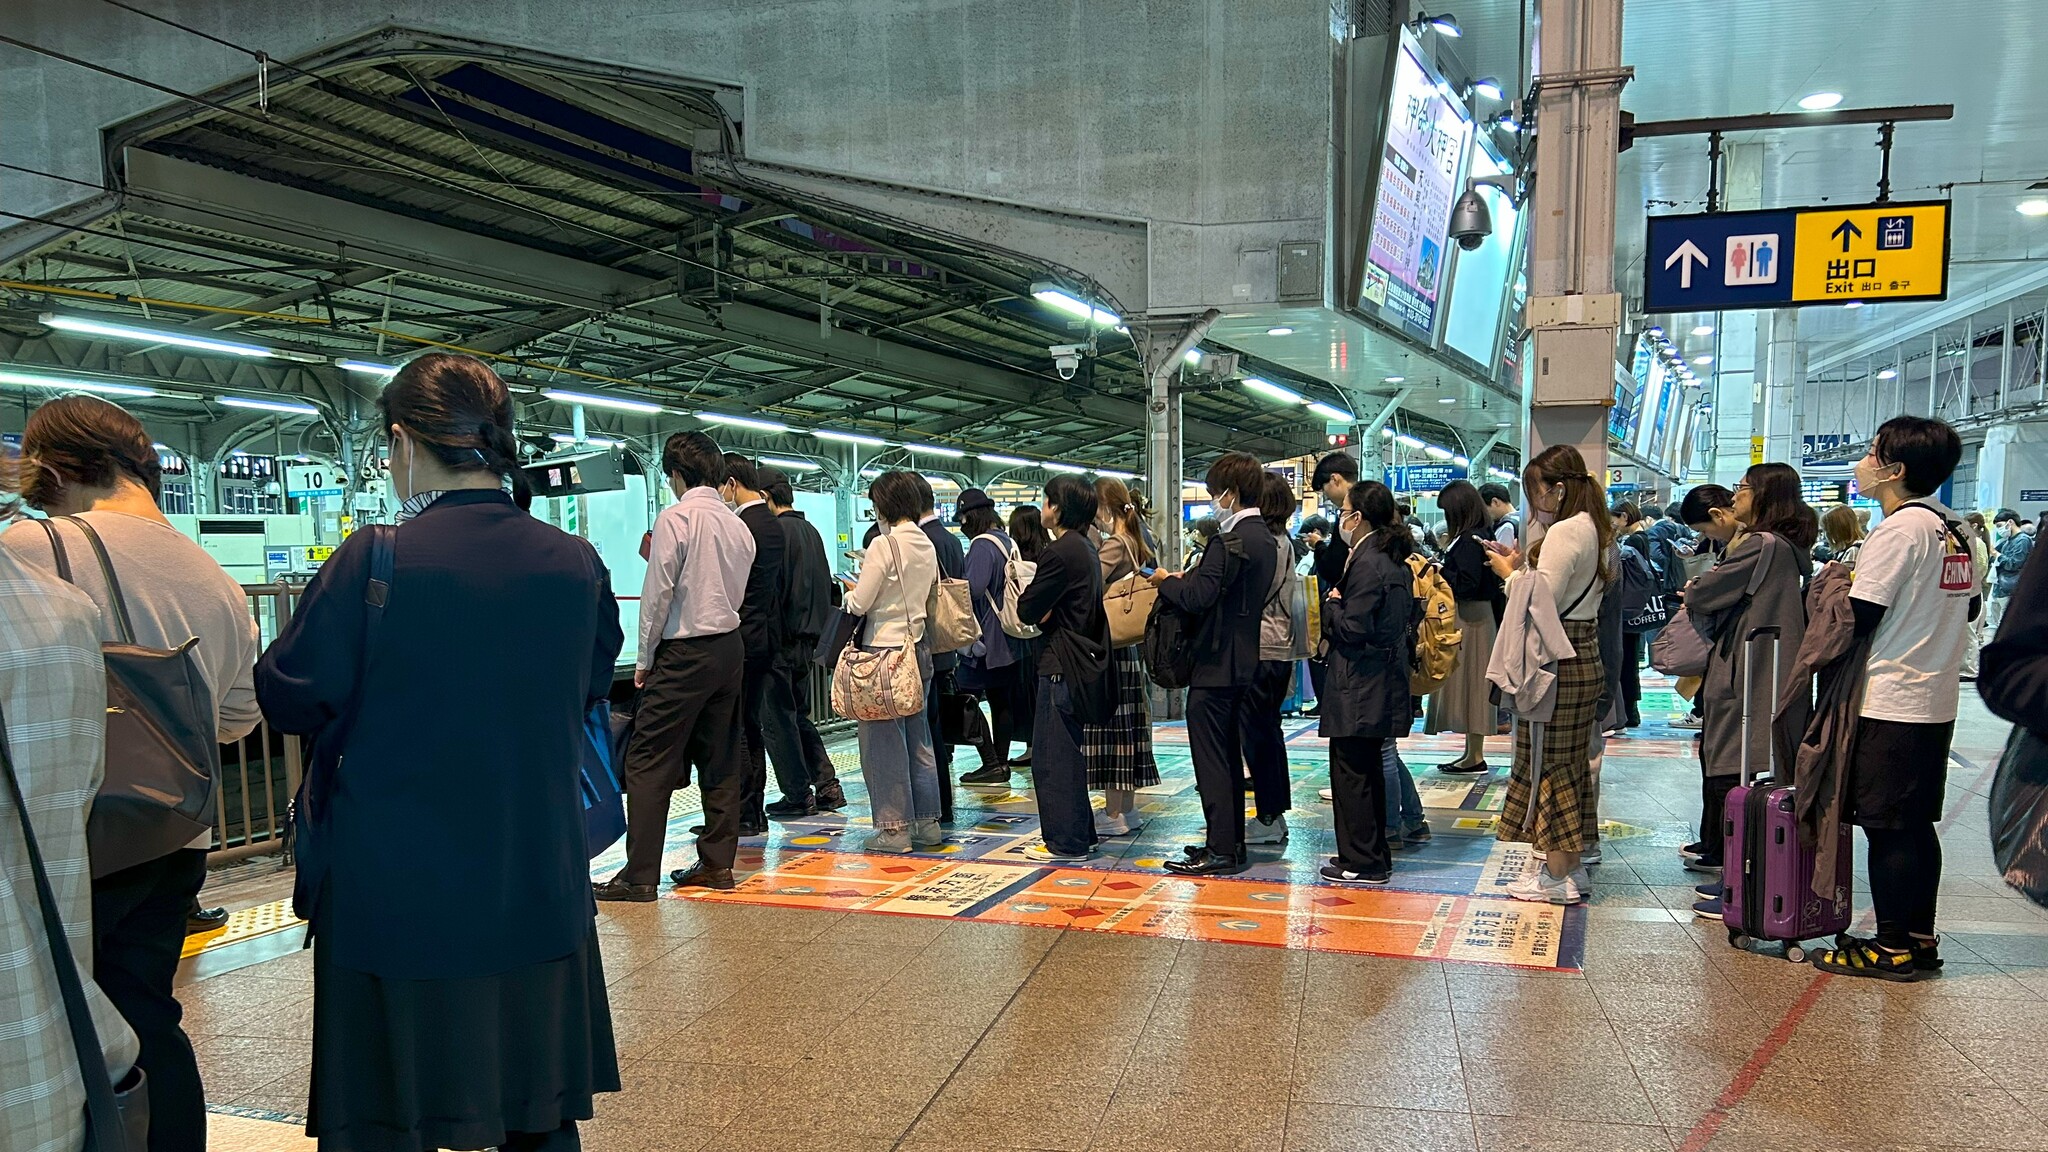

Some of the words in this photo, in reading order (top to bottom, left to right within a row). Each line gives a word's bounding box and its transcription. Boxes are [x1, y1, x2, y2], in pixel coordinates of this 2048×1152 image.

[1826, 259, 1876, 280] 出口
[1825, 282, 1854, 294] Exit
[1861, 282, 1883, 292] 出口
[304, 471, 323, 489] 10
[1613, 469, 1622, 483] 3
[1627, 613, 1657, 626] COFFEE
